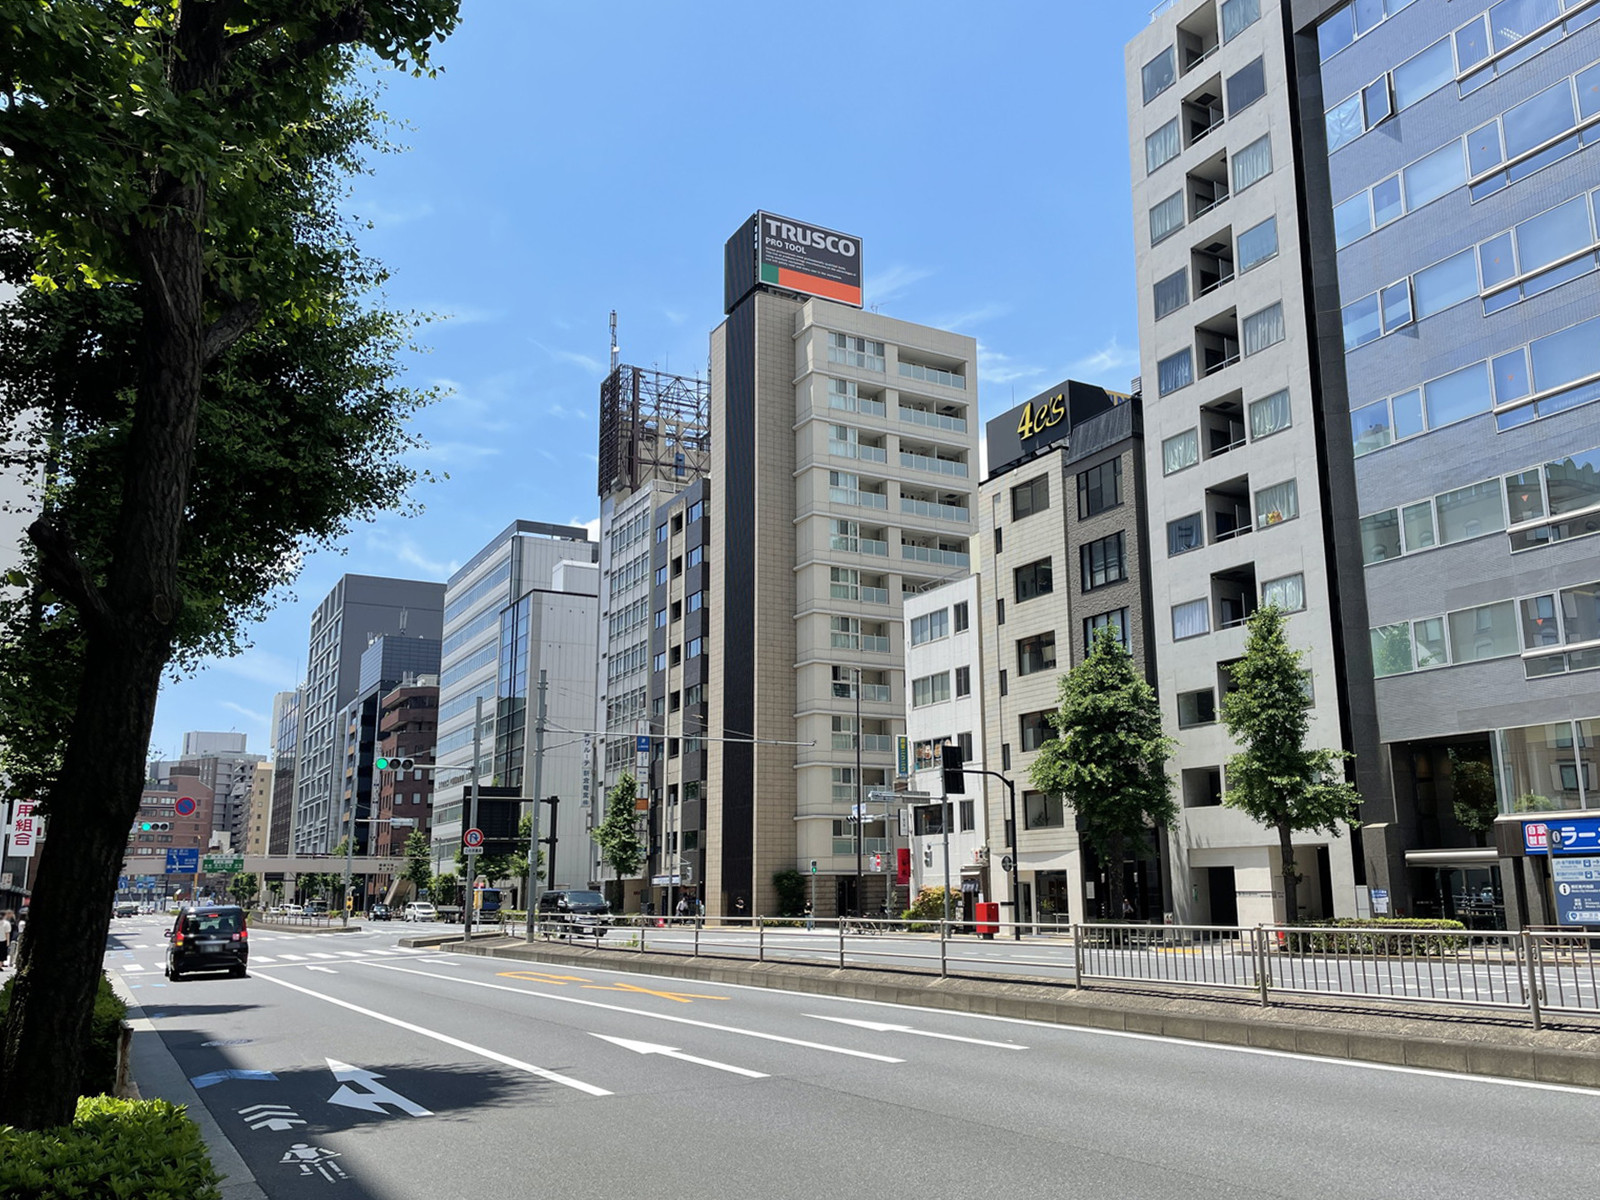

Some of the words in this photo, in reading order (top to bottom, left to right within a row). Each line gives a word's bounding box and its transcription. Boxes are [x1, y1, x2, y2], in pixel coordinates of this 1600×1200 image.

[766, 219, 855, 257] TRUSCO
[766, 237, 783, 248] PRO
[785, 242, 806, 254] TOOL
[14, 799, 34, 845] 用組合
[1561, 826, 1600, 845] ラー
